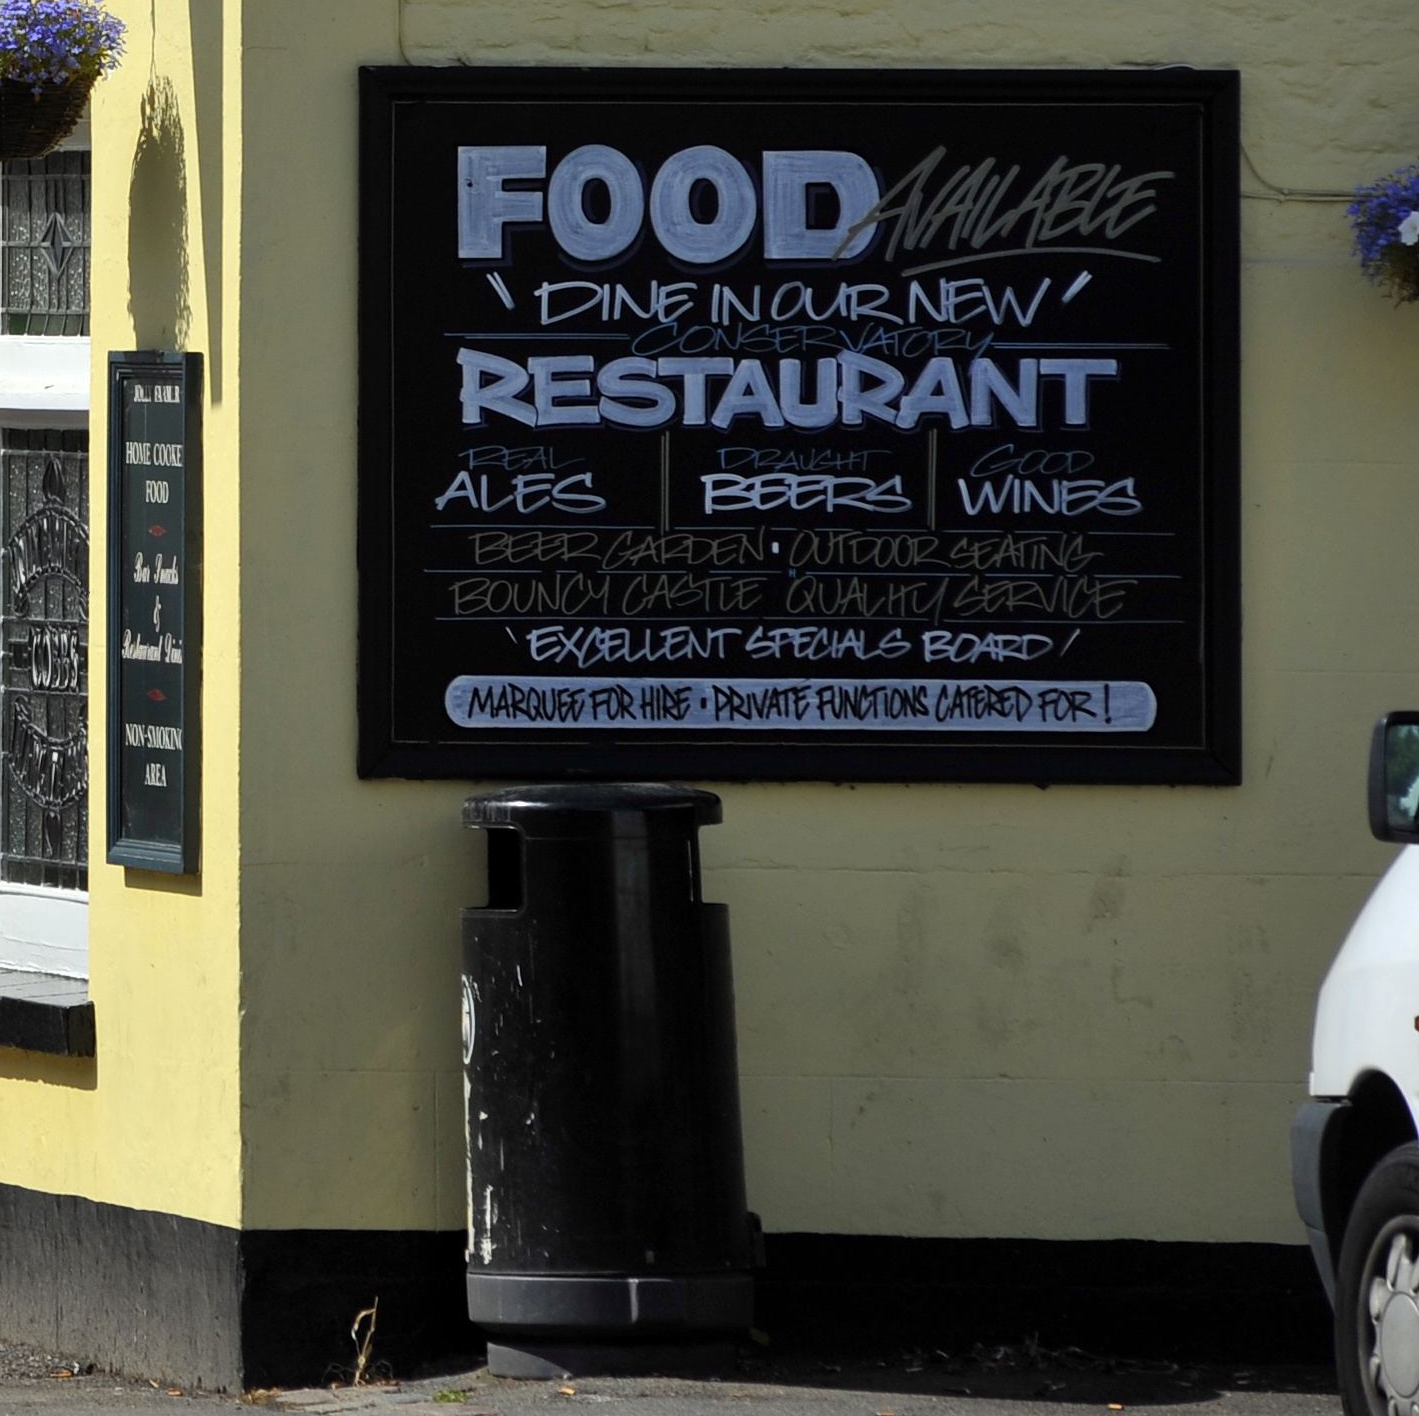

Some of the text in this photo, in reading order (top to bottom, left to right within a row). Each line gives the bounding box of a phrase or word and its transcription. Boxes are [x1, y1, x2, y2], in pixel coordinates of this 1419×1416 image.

[458, 144, 1175, 264] FOOD AVAILABLE
[533, 277, 1051, 327] DINE IN OUR NEW
[631, 322, 995, 359] CONSERVATORY
[456, 348, 1118, 430] RESTAURANT
[125, 441, 151, 465] HOME
[458, 445, 586, 471] REAL
[717, 447, 892, 472] DRAUGHT
[970, 444, 1095, 477] GOOD
[145, 480, 169, 504] FOOD
[435, 470, 607, 514] ALES
[700, 472, 912, 515] BEERS
[957, 473, 1144, 516] WINES
[133, 551, 150, 583] Bar
[467, 526, 1105, 572] BEER GARDEN OUTDOOR SEATING
[153, 595, 162, 633] &
[448, 573, 1138, 626] BOUNCY CASTLE QUALITY SERVICE
[526, 625, 1054, 670] EXCELLENT SPECIALS BOARD
[467, 683, 587, 723] MARQUEE
[589, 684, 638, 722] FOR
[639, 683, 693, 721] HIRE
[712, 684, 812, 723] PRIVATE
[816, 684, 930, 722] FUNCTIONS
[934, 684, 1034, 723] CATERED
[144, 762, 167, 787] AREA
